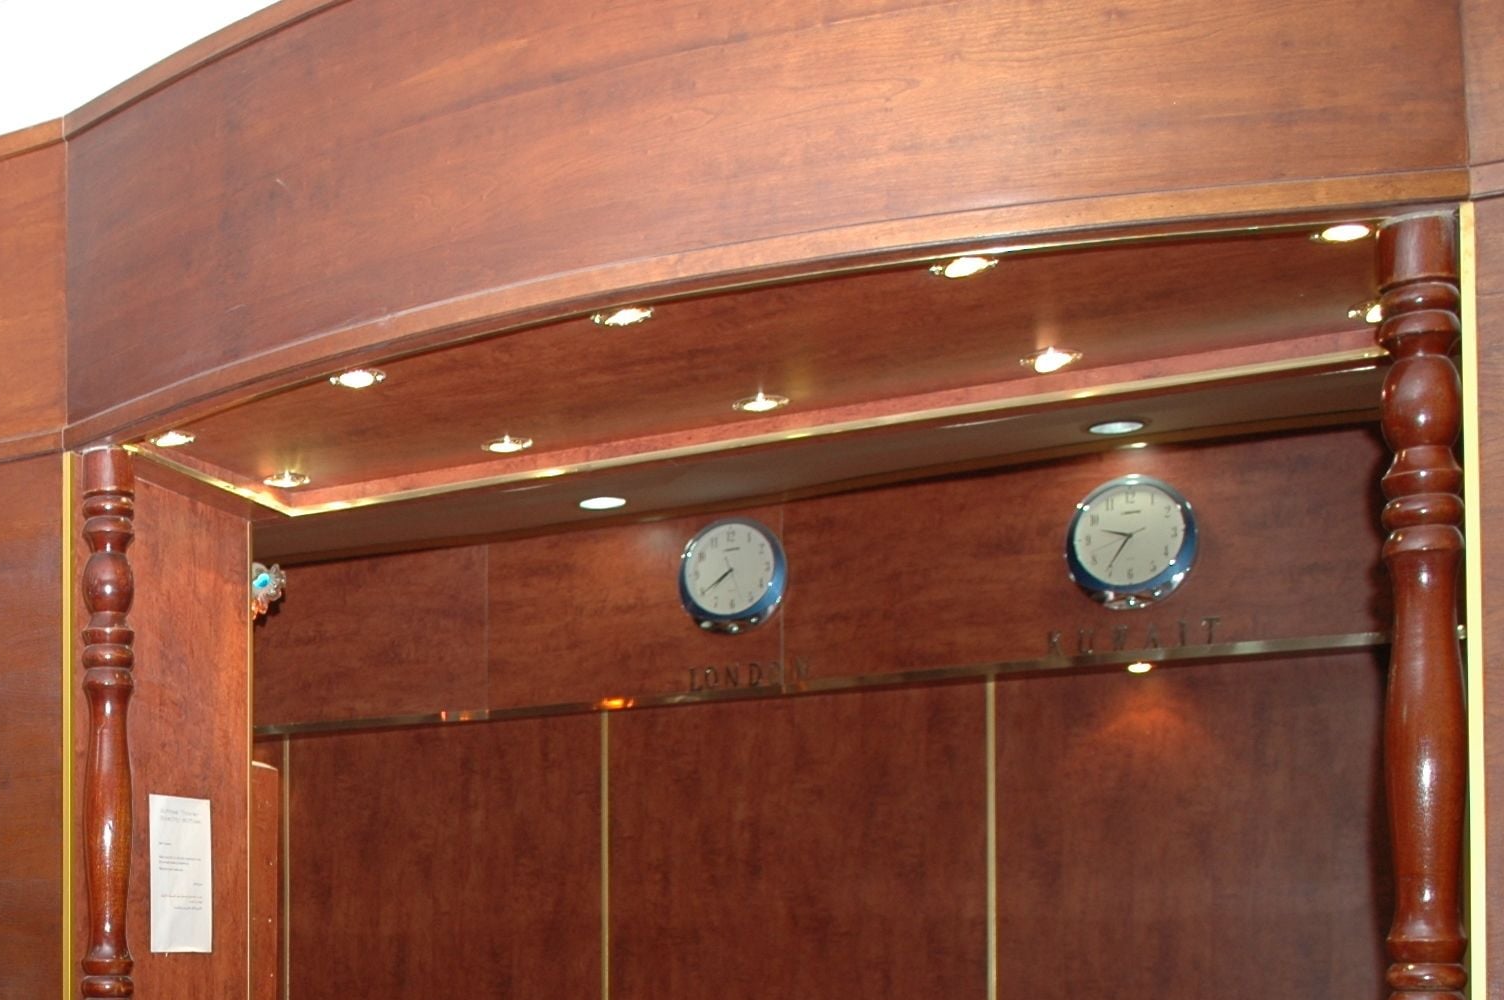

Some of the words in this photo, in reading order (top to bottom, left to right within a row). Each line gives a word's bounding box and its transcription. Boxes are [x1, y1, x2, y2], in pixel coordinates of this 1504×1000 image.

[1105, 496, 1114, 511] 11
[1125, 491, 1136, 504] 12
[1164, 505, 1172, 518] 2
[1090, 514, 1099, 527] 10
[1048, 616, 1221, 656] KUWAIT
[688, 656, 809, 692] LONDON
